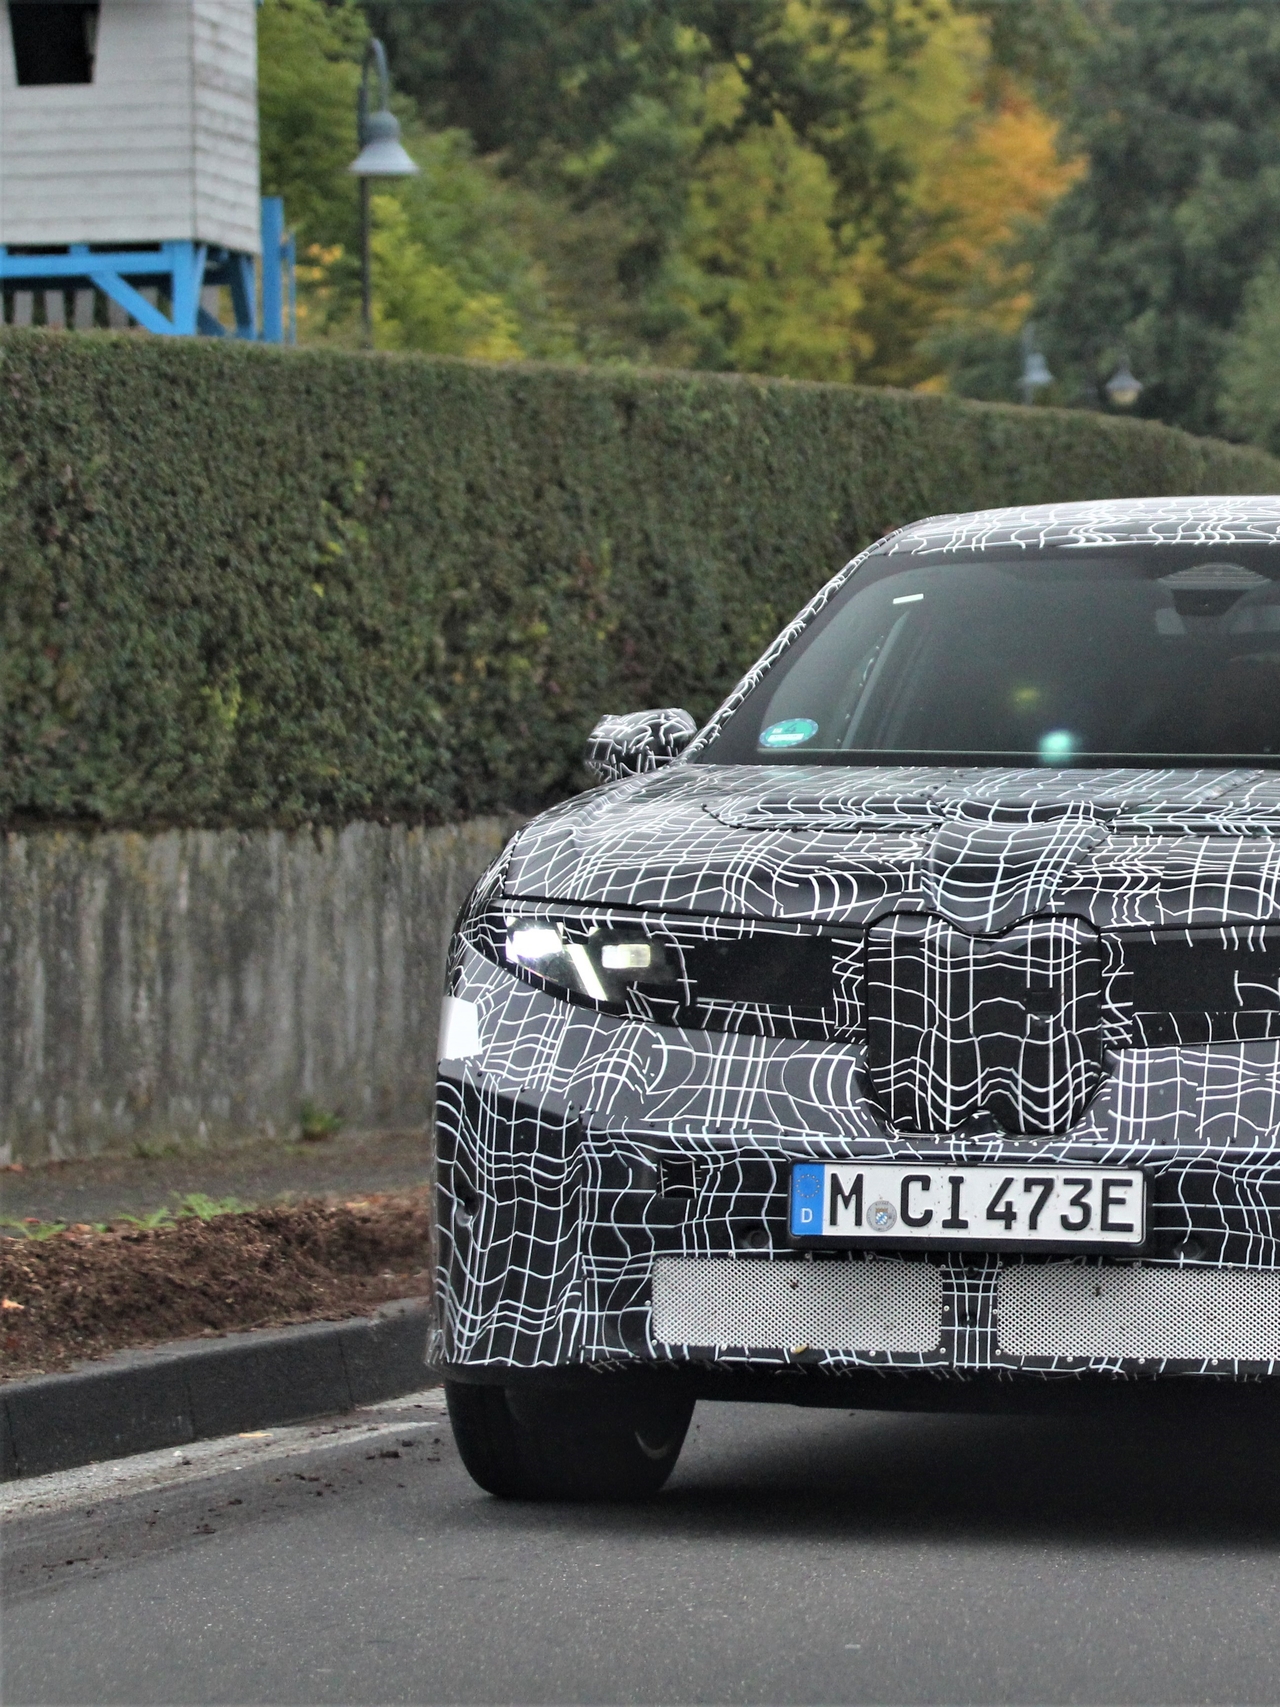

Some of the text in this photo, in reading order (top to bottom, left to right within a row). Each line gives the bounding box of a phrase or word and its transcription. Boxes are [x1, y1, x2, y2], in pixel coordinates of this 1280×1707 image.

[801, 1208, 813, 1223] D
[829, 1173, 864, 1226] M
[900, 1174, 969, 1229] CI
[986, 1177, 1134, 1232] 473E
